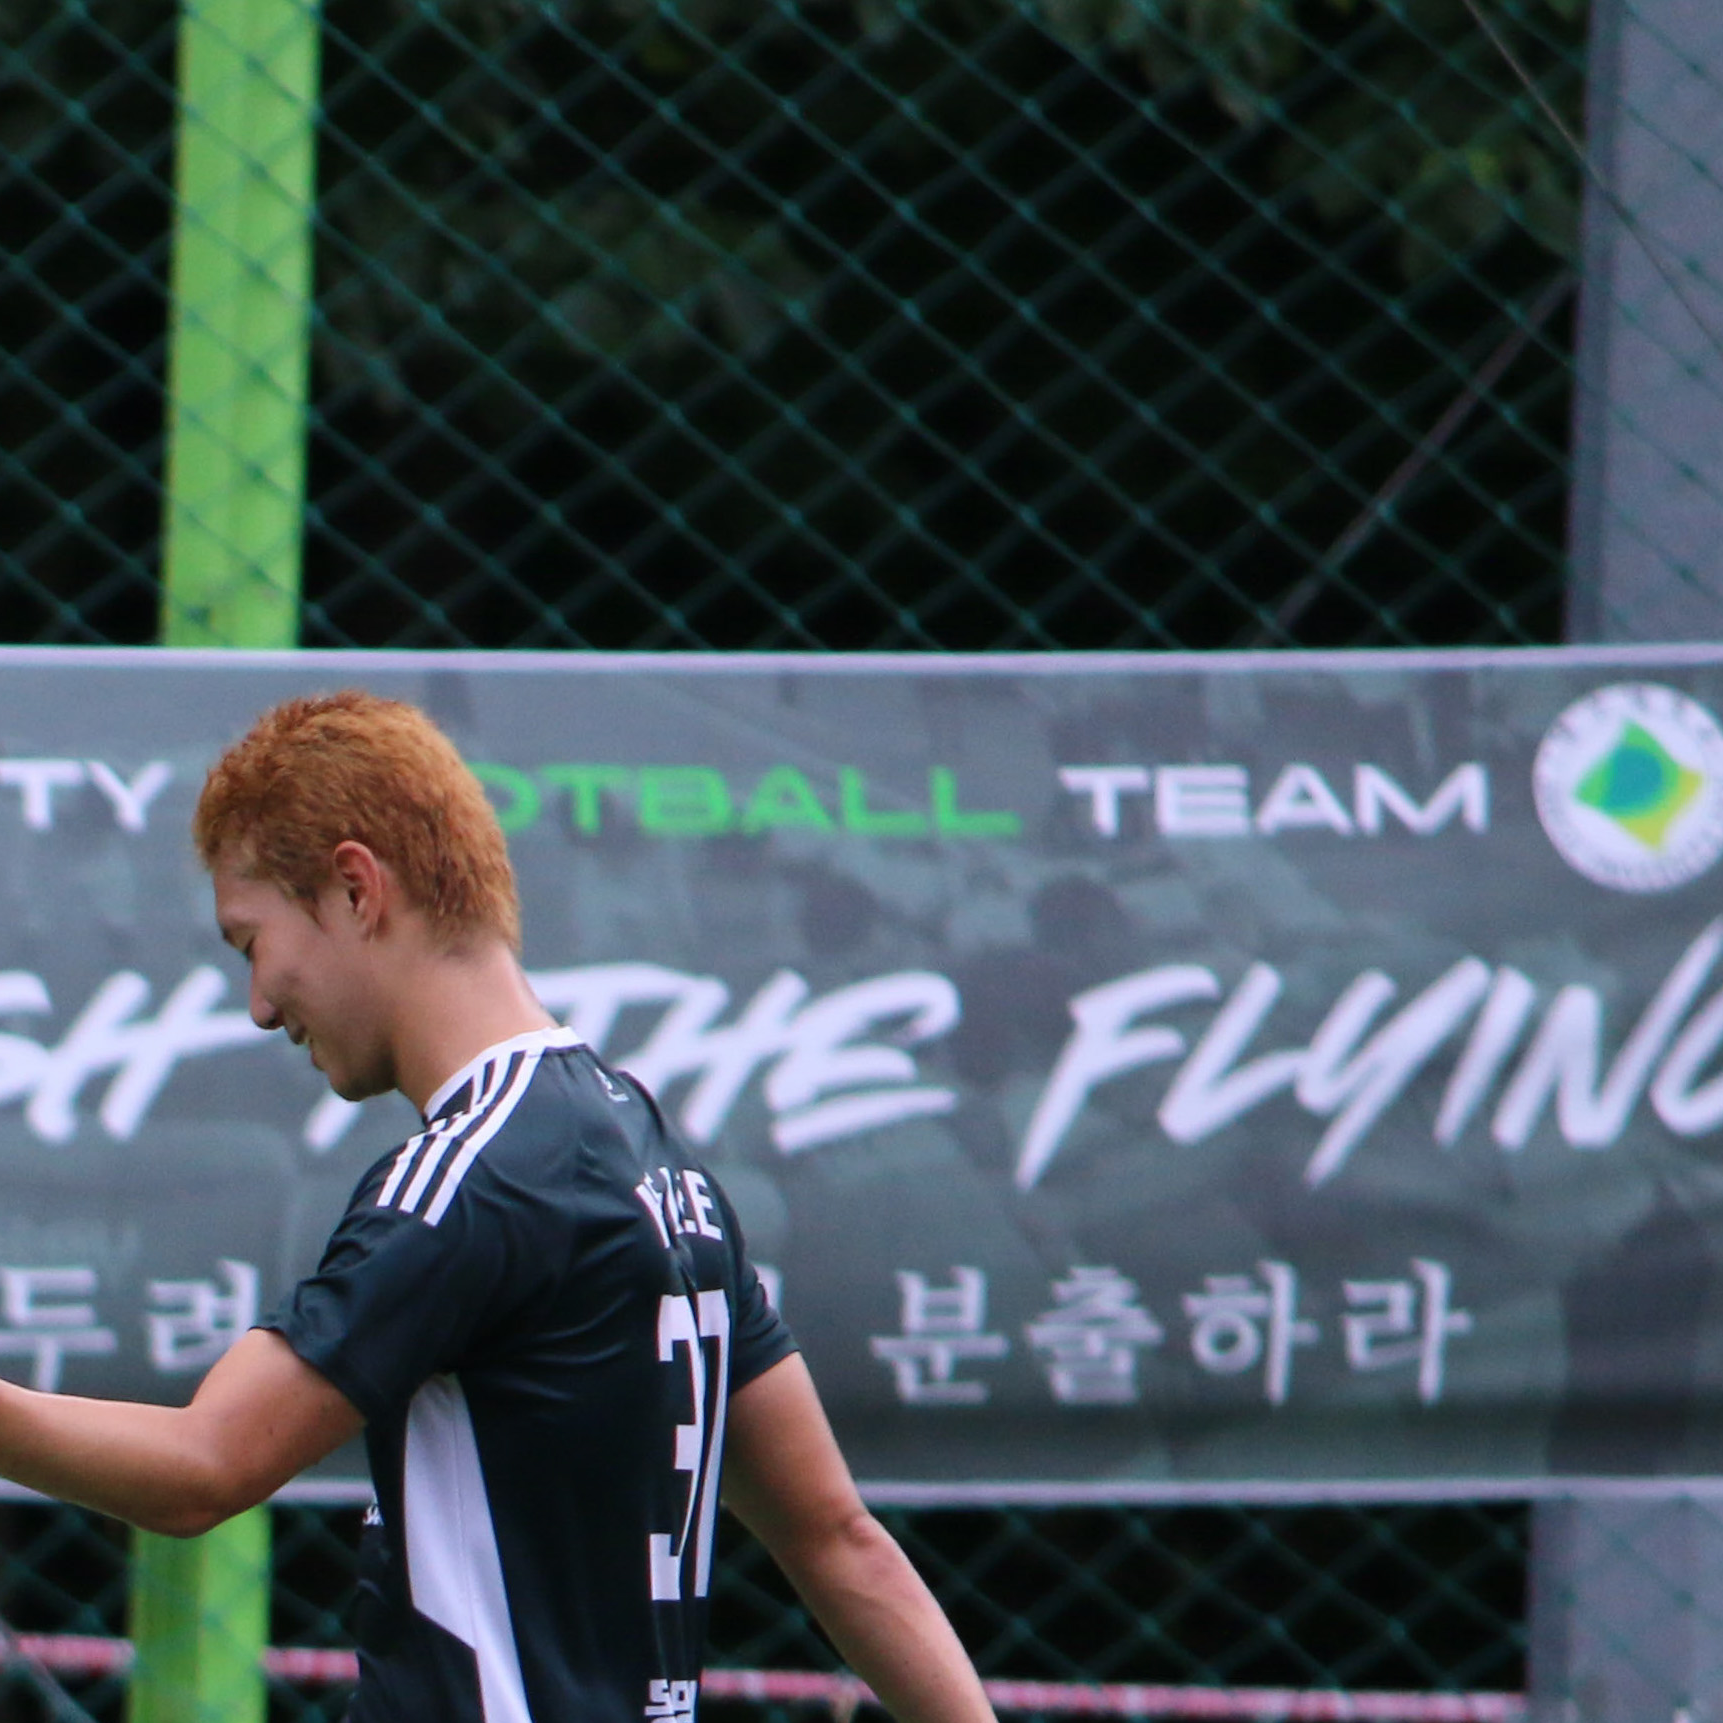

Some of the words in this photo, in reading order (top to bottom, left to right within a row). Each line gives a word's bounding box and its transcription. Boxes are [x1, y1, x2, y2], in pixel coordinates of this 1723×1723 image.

[460, 760, 1025, 840] OTBALL
[1057, 762, 1490, 837] TEAM
[869, 1256, 1475, 1406] 분출하라
[649, 1288, 731, 1601] 37
